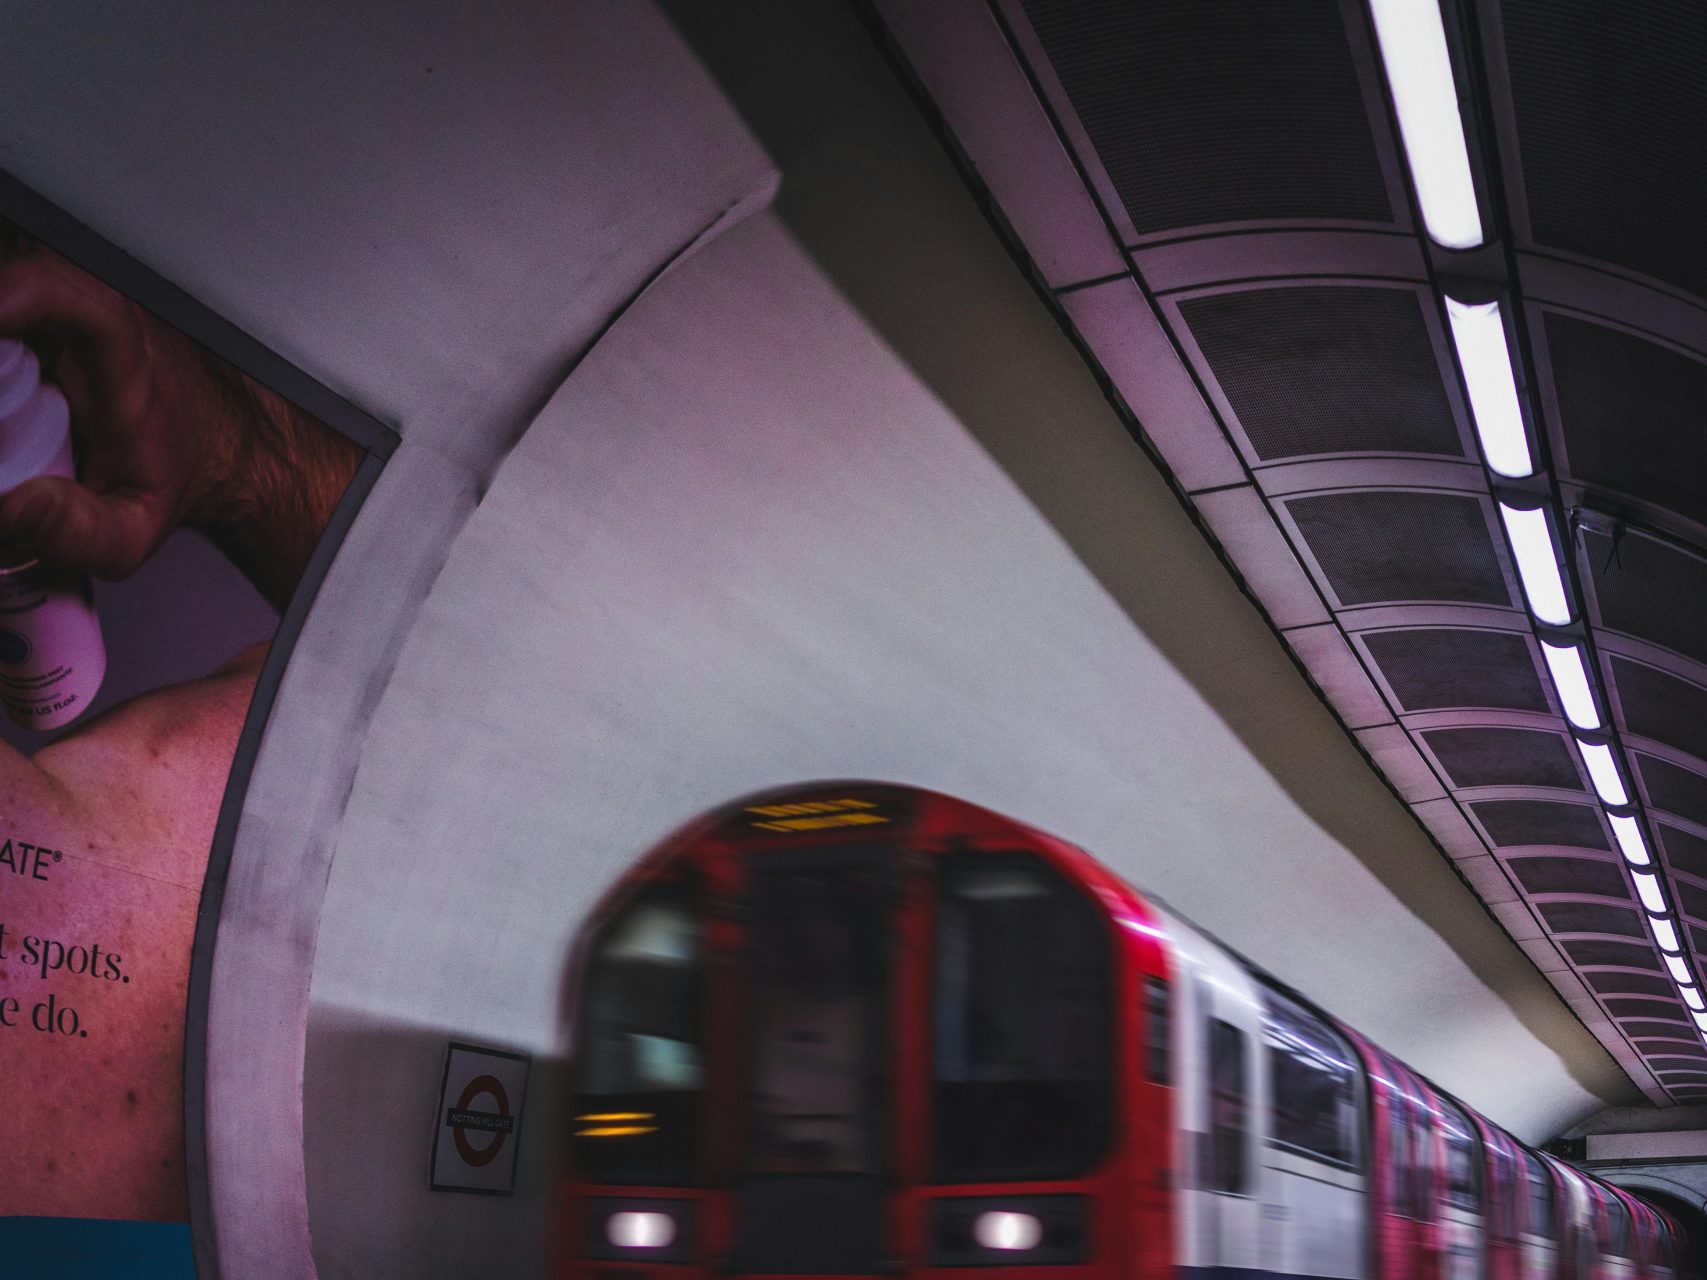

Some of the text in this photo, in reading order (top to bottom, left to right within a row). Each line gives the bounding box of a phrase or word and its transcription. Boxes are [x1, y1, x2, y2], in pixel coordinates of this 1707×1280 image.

[20, 935, 130, 983] spots.
[32, 994, 88, 1038] do.
[452, 1112, 512, 1129] NOTTING HILL GATE
